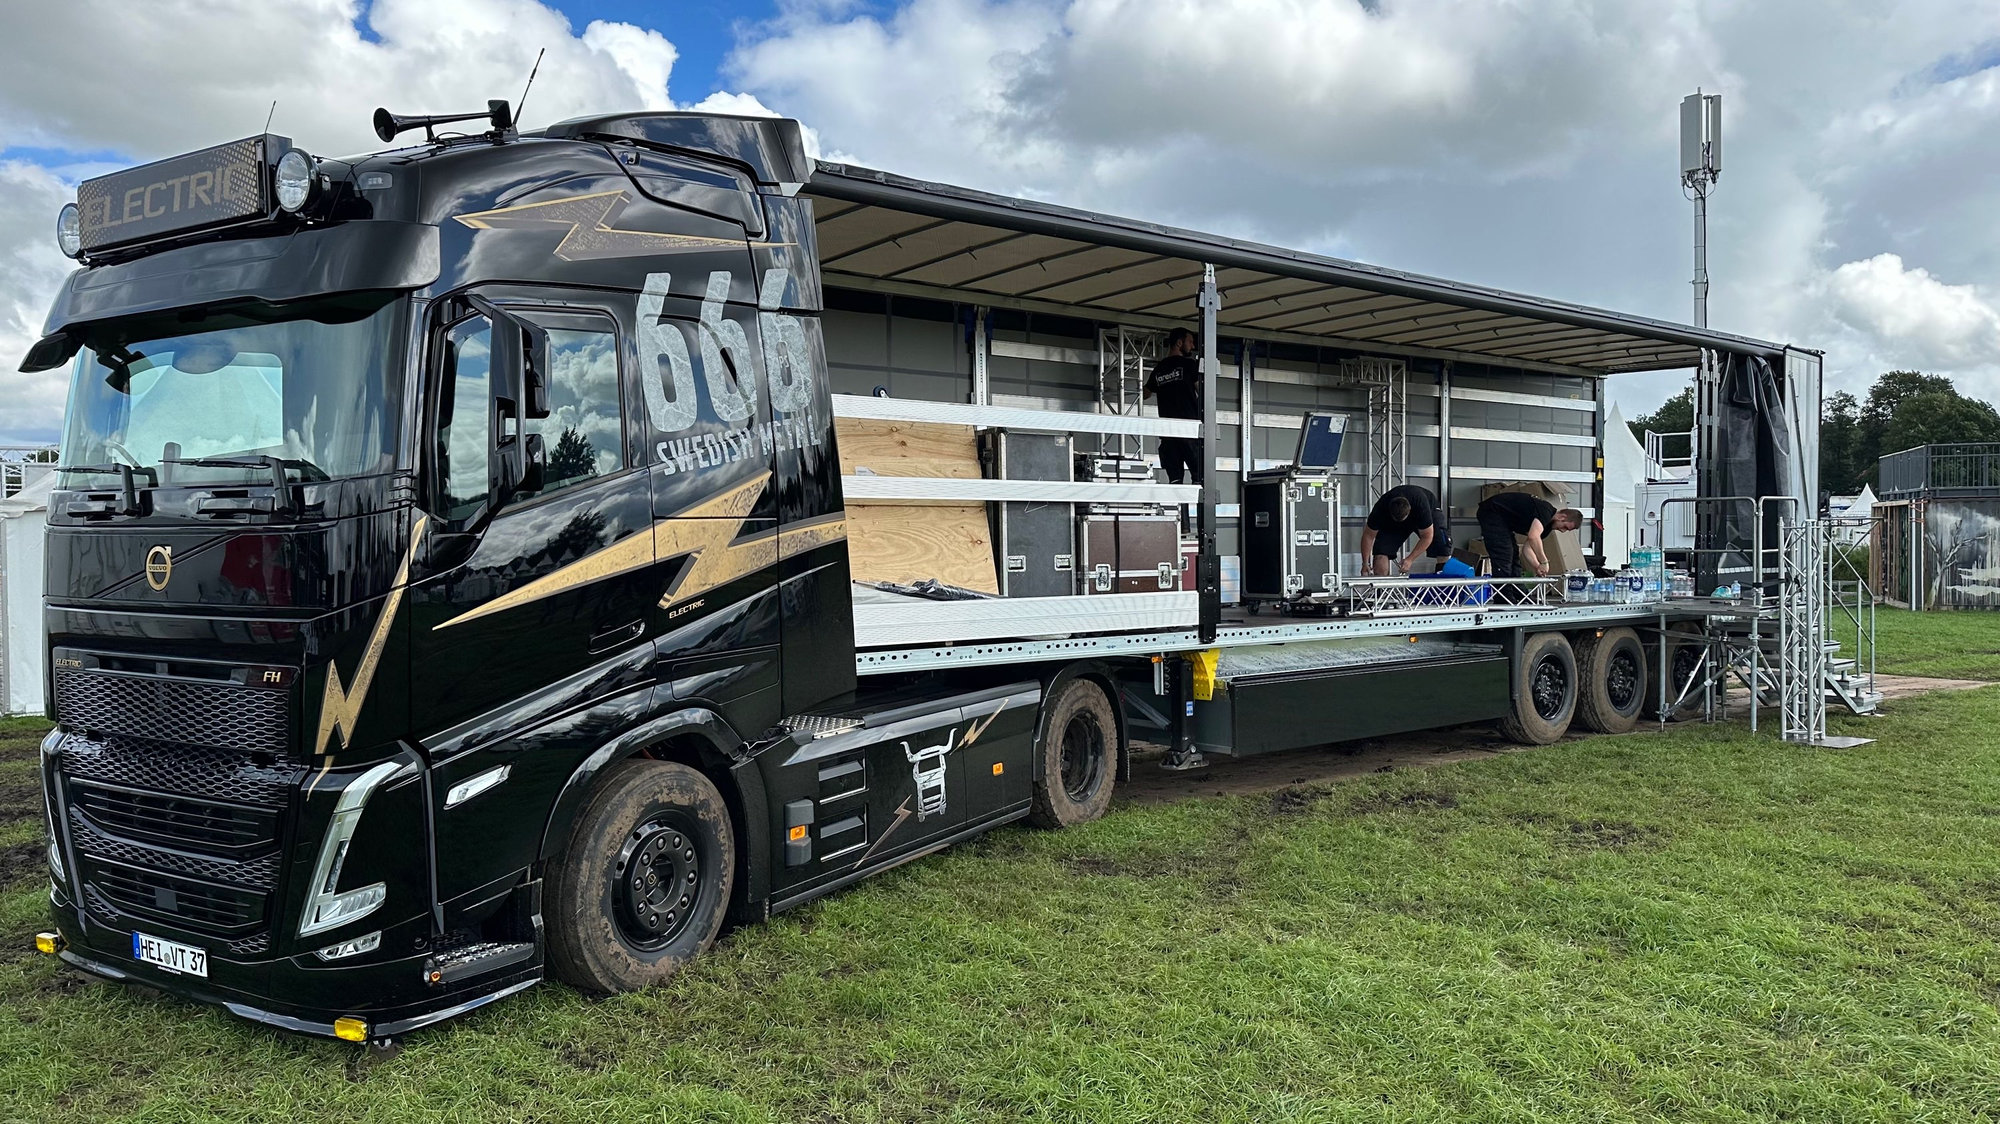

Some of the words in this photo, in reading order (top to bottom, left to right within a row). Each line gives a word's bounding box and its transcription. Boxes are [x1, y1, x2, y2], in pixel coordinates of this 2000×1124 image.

[84, 161, 249, 230] ELECTRIC
[636, 268, 813, 432] 666
[656, 427, 755, 476] SWEDISH
[758, 414, 822, 456] METAL
[669, 599, 705, 619] ELECTRIC
[55, 658, 82, 668] ELECTRIC
[263, 671, 281, 683] FH
[140, 938, 163, 962] HEI
[170, 946, 186, 968] VT
[189, 950, 204, 972] 37
